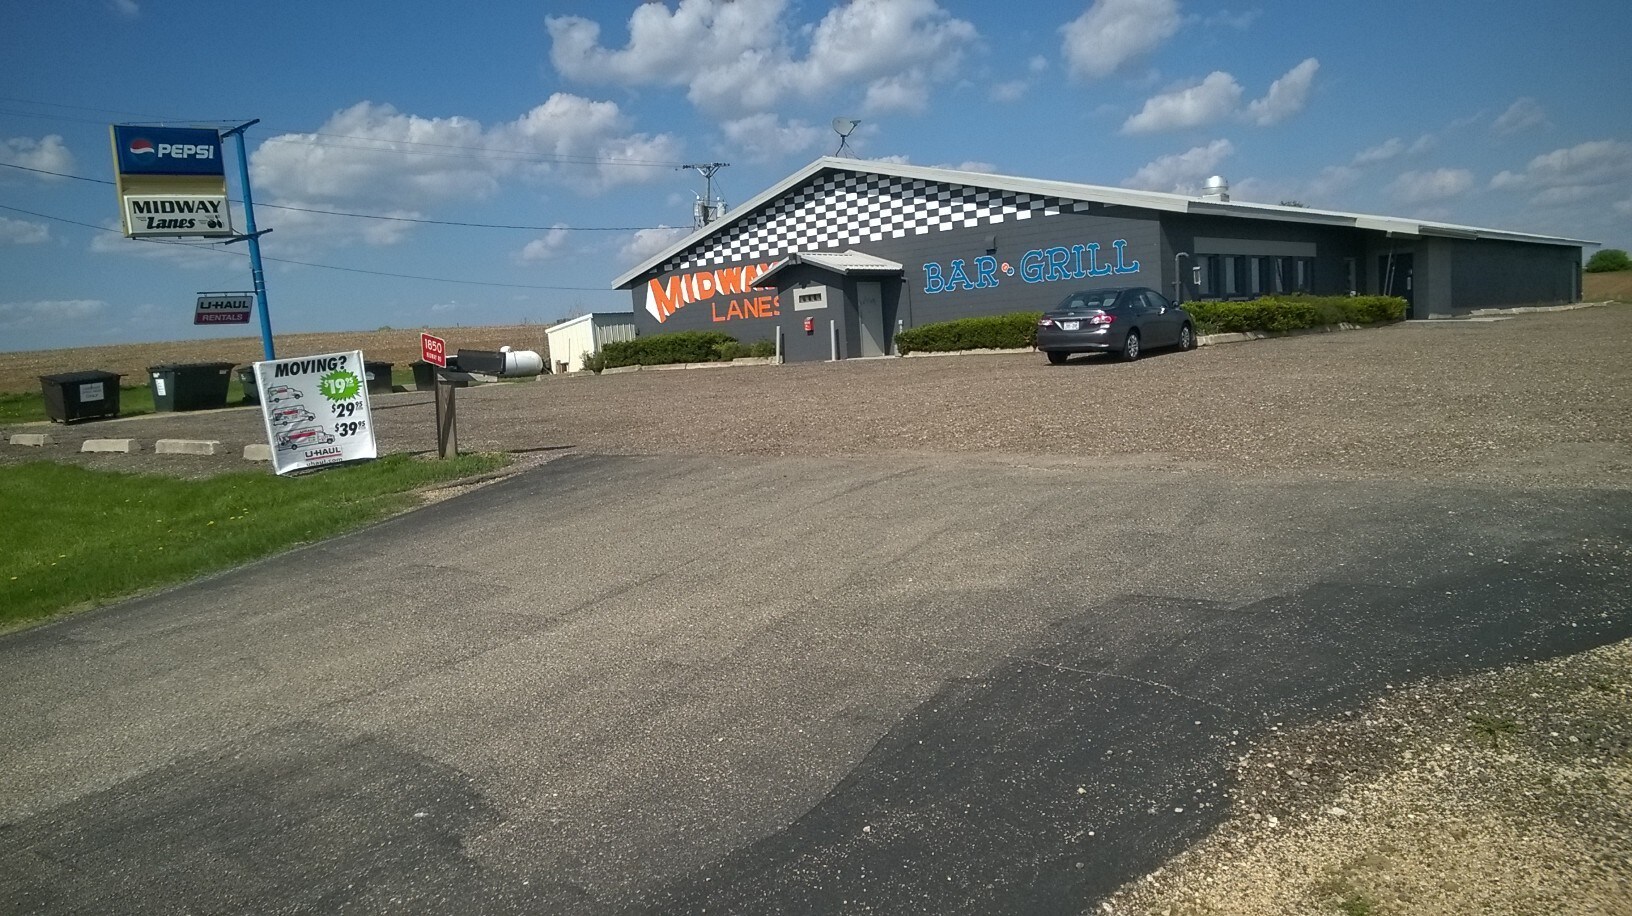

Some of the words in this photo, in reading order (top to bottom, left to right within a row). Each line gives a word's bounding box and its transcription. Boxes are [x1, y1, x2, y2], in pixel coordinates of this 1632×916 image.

[157, 143, 214, 159] PEPSI
[132, 200, 222, 215] MIDWAY
[146, 216, 196, 230] Lanes
[922, 255, 1000, 295] BAR
[1019, 238, 1141, 284] GRILL
[200, 300, 249, 309] U-HAUL
[202, 313, 243, 321] RENTALS
[274, 355, 348, 378] MOVING?
[305, 446, 341, 458] U-HAUL
